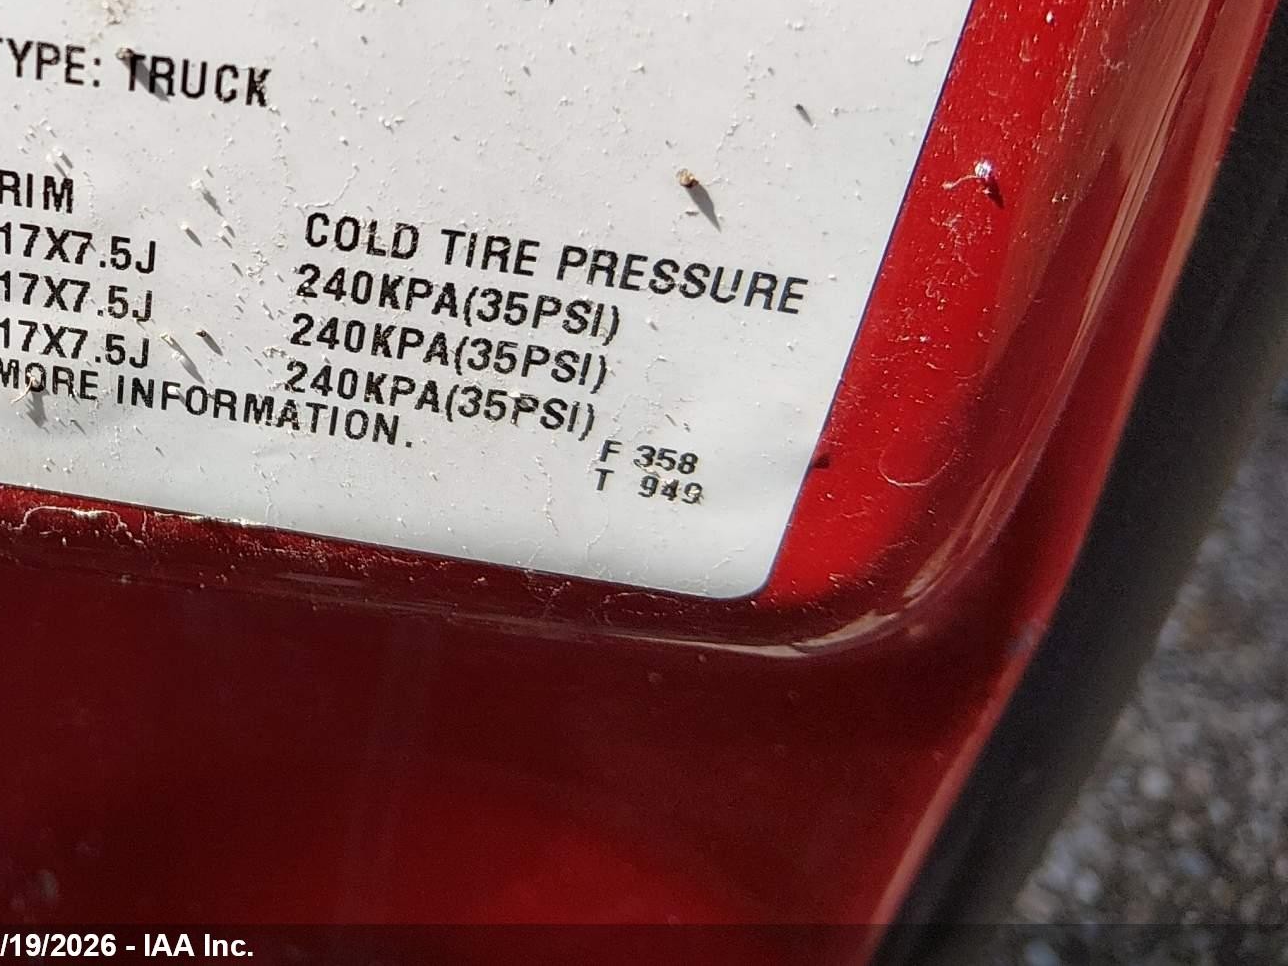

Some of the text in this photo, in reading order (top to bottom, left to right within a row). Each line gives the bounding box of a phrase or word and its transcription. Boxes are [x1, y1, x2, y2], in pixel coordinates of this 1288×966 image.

[125, 53, 272, 107] TRUCK
[304, 212, 809, 315] COLD TIRE PRESSURE
[295, 263, 621, 346] 240KPA(35PSI)
[290, 312, 610, 395] 240KPA(35PSI)
[116, 374, 413, 449] INFORMATION.
[284, 360, 597, 442] 240KPA(35PSI)
[594, 467, 616, 491] T
[599, 439, 699, 475] F 358
